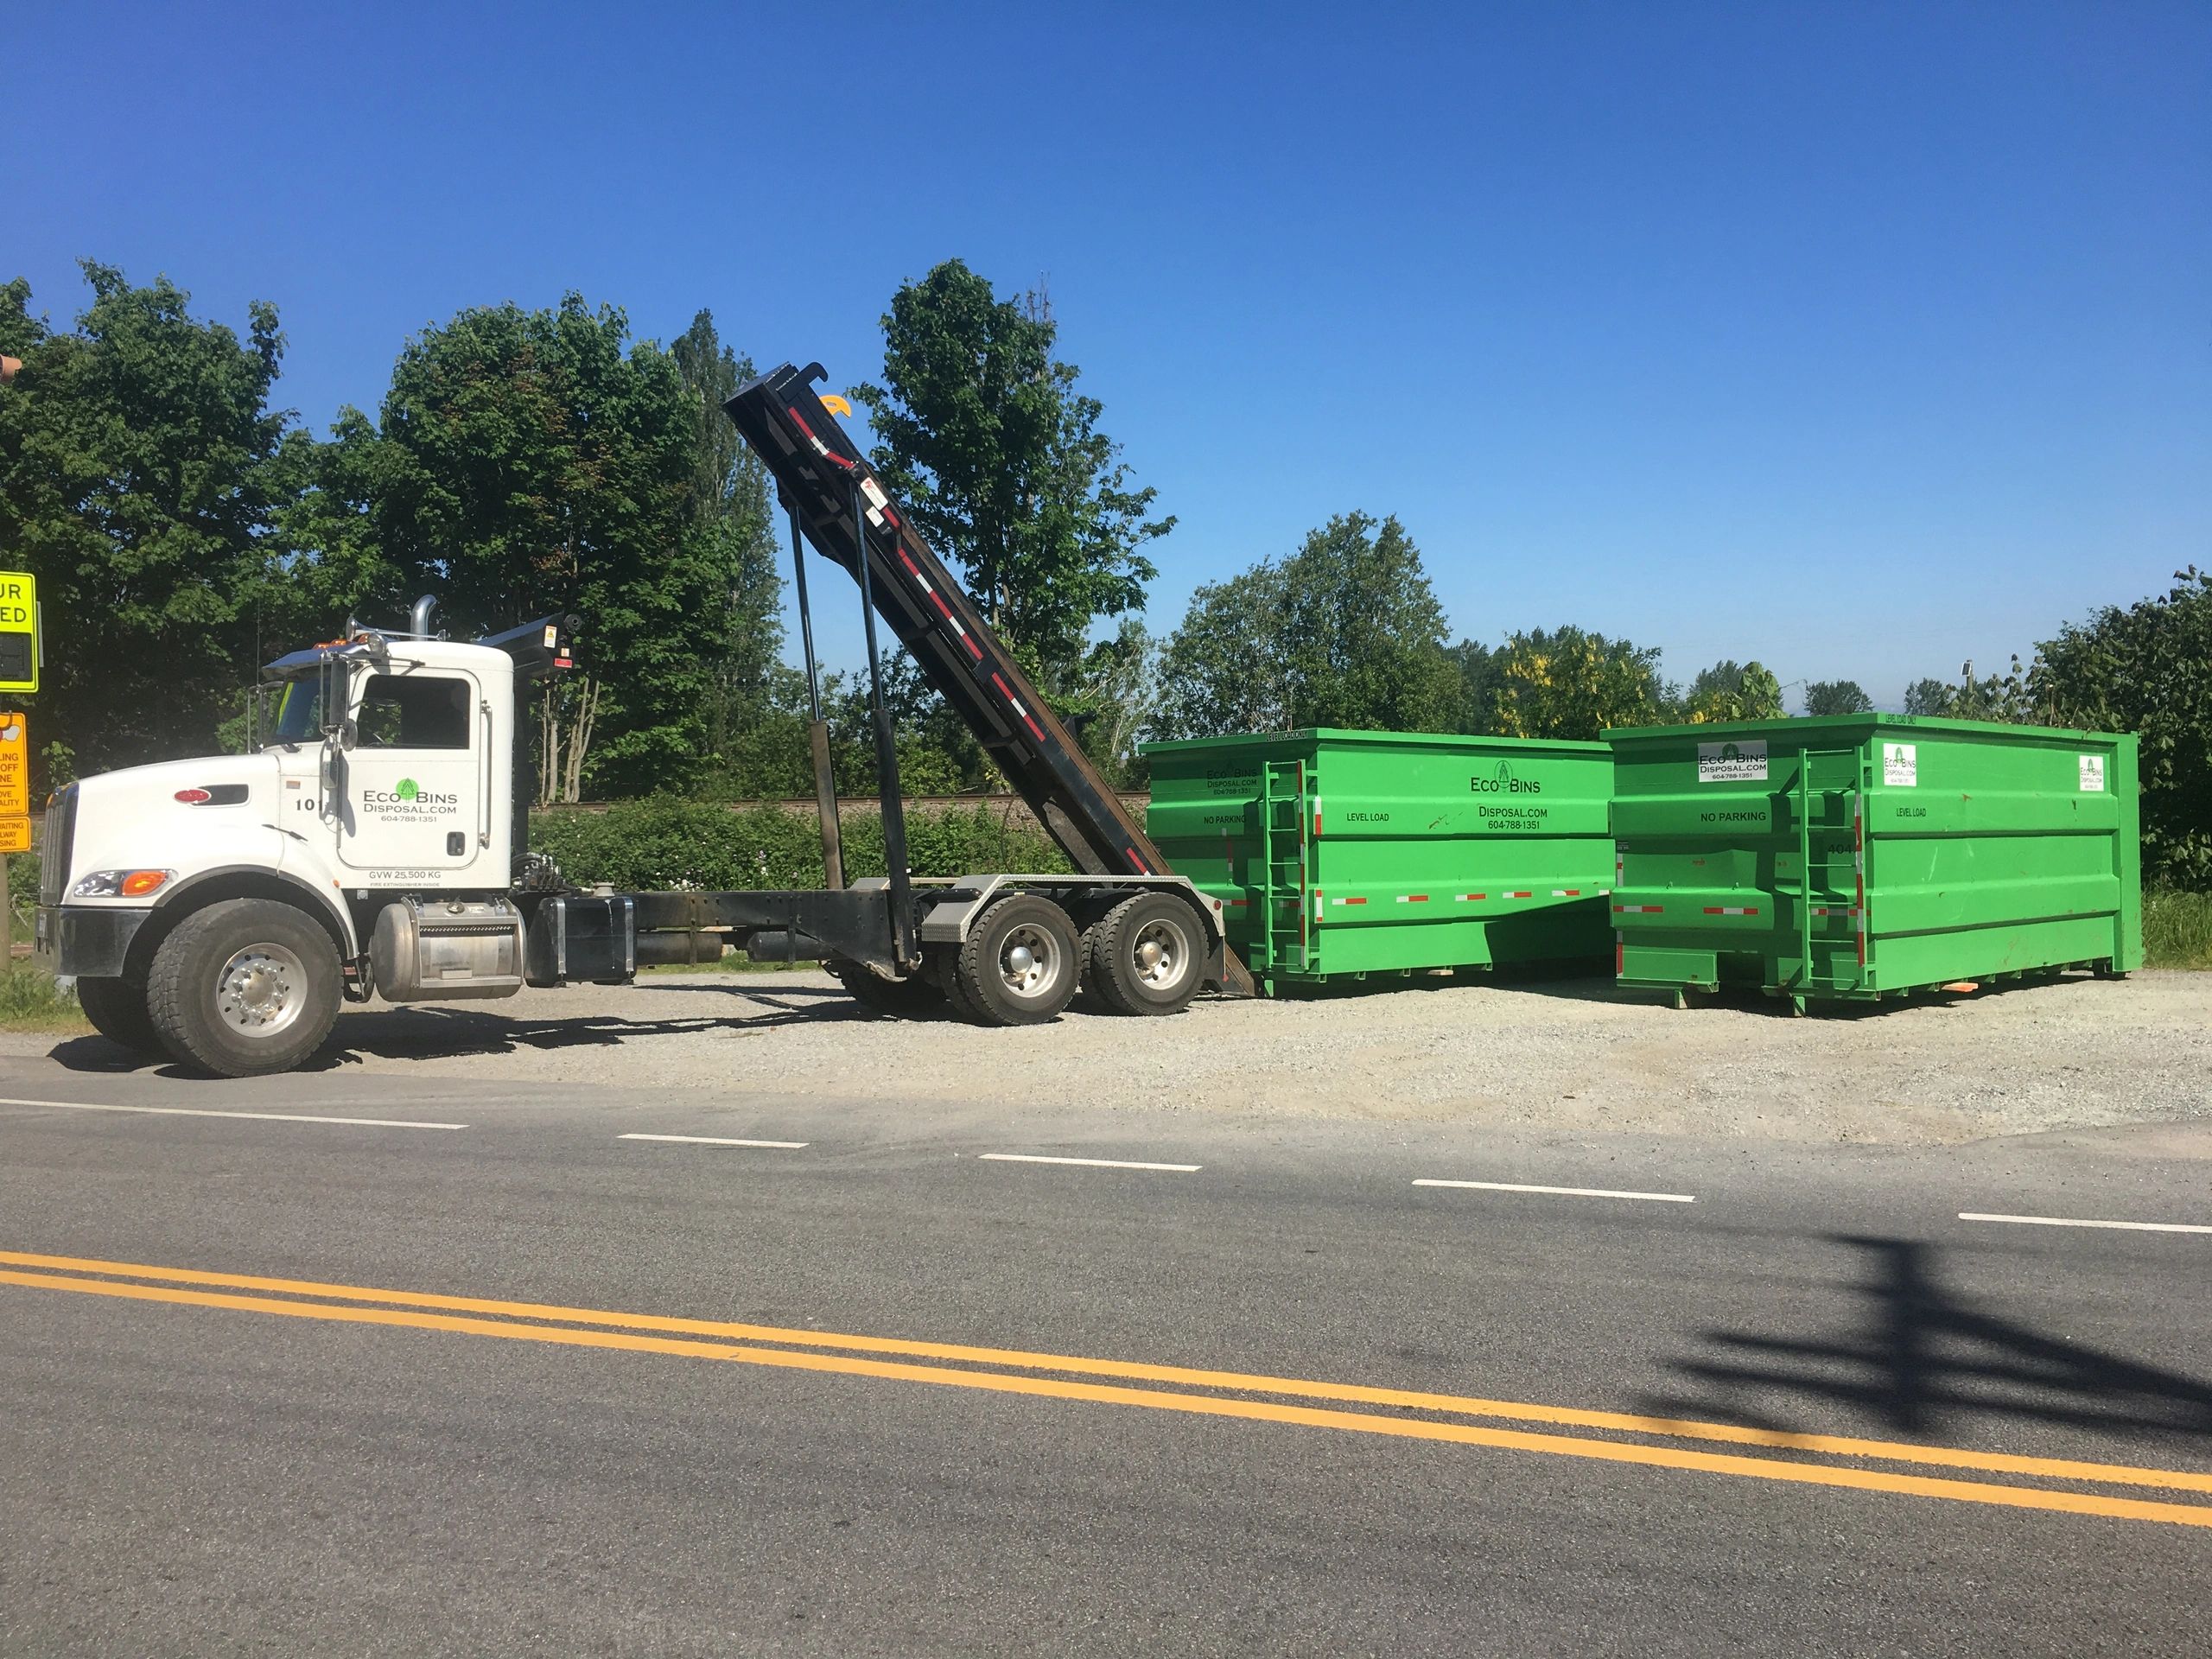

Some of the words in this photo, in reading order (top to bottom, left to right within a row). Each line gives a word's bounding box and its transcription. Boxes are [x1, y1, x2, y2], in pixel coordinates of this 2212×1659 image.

[0, 607, 27, 623] ED
[1699, 755, 1726, 765] ECO
[1736, 753, 1767, 763] BINS
[1885, 757, 1897, 767] ECO
[0, 763, 19, 772] OFF
[1700, 764, 1767, 773] DISPOSAL.COM
[1471, 777, 1499, 792] ECO
[1510, 779, 1541, 793] BINS
[363, 790, 402, 803] ECO
[416, 791, 458, 804] BINS
[364, 804, 456, 814] DISPOSAL.COM
[1478, 806, 1548, 818] DISPOSAL.COM
[1896, 807, 1912, 817] LEVEL
[1912, 808, 1926, 817] LOAD
[1204, 816, 1214, 824] NO
[1215, 815, 1246, 823] PARKING
[1346, 813, 1370, 822] LEVEL
[1370, 813, 1389, 822] LOAD
[1700, 813, 1716, 822] NO
[1719, 811, 1766, 822] PARKING
[1488, 821, 1540, 830] 604-788-1351
